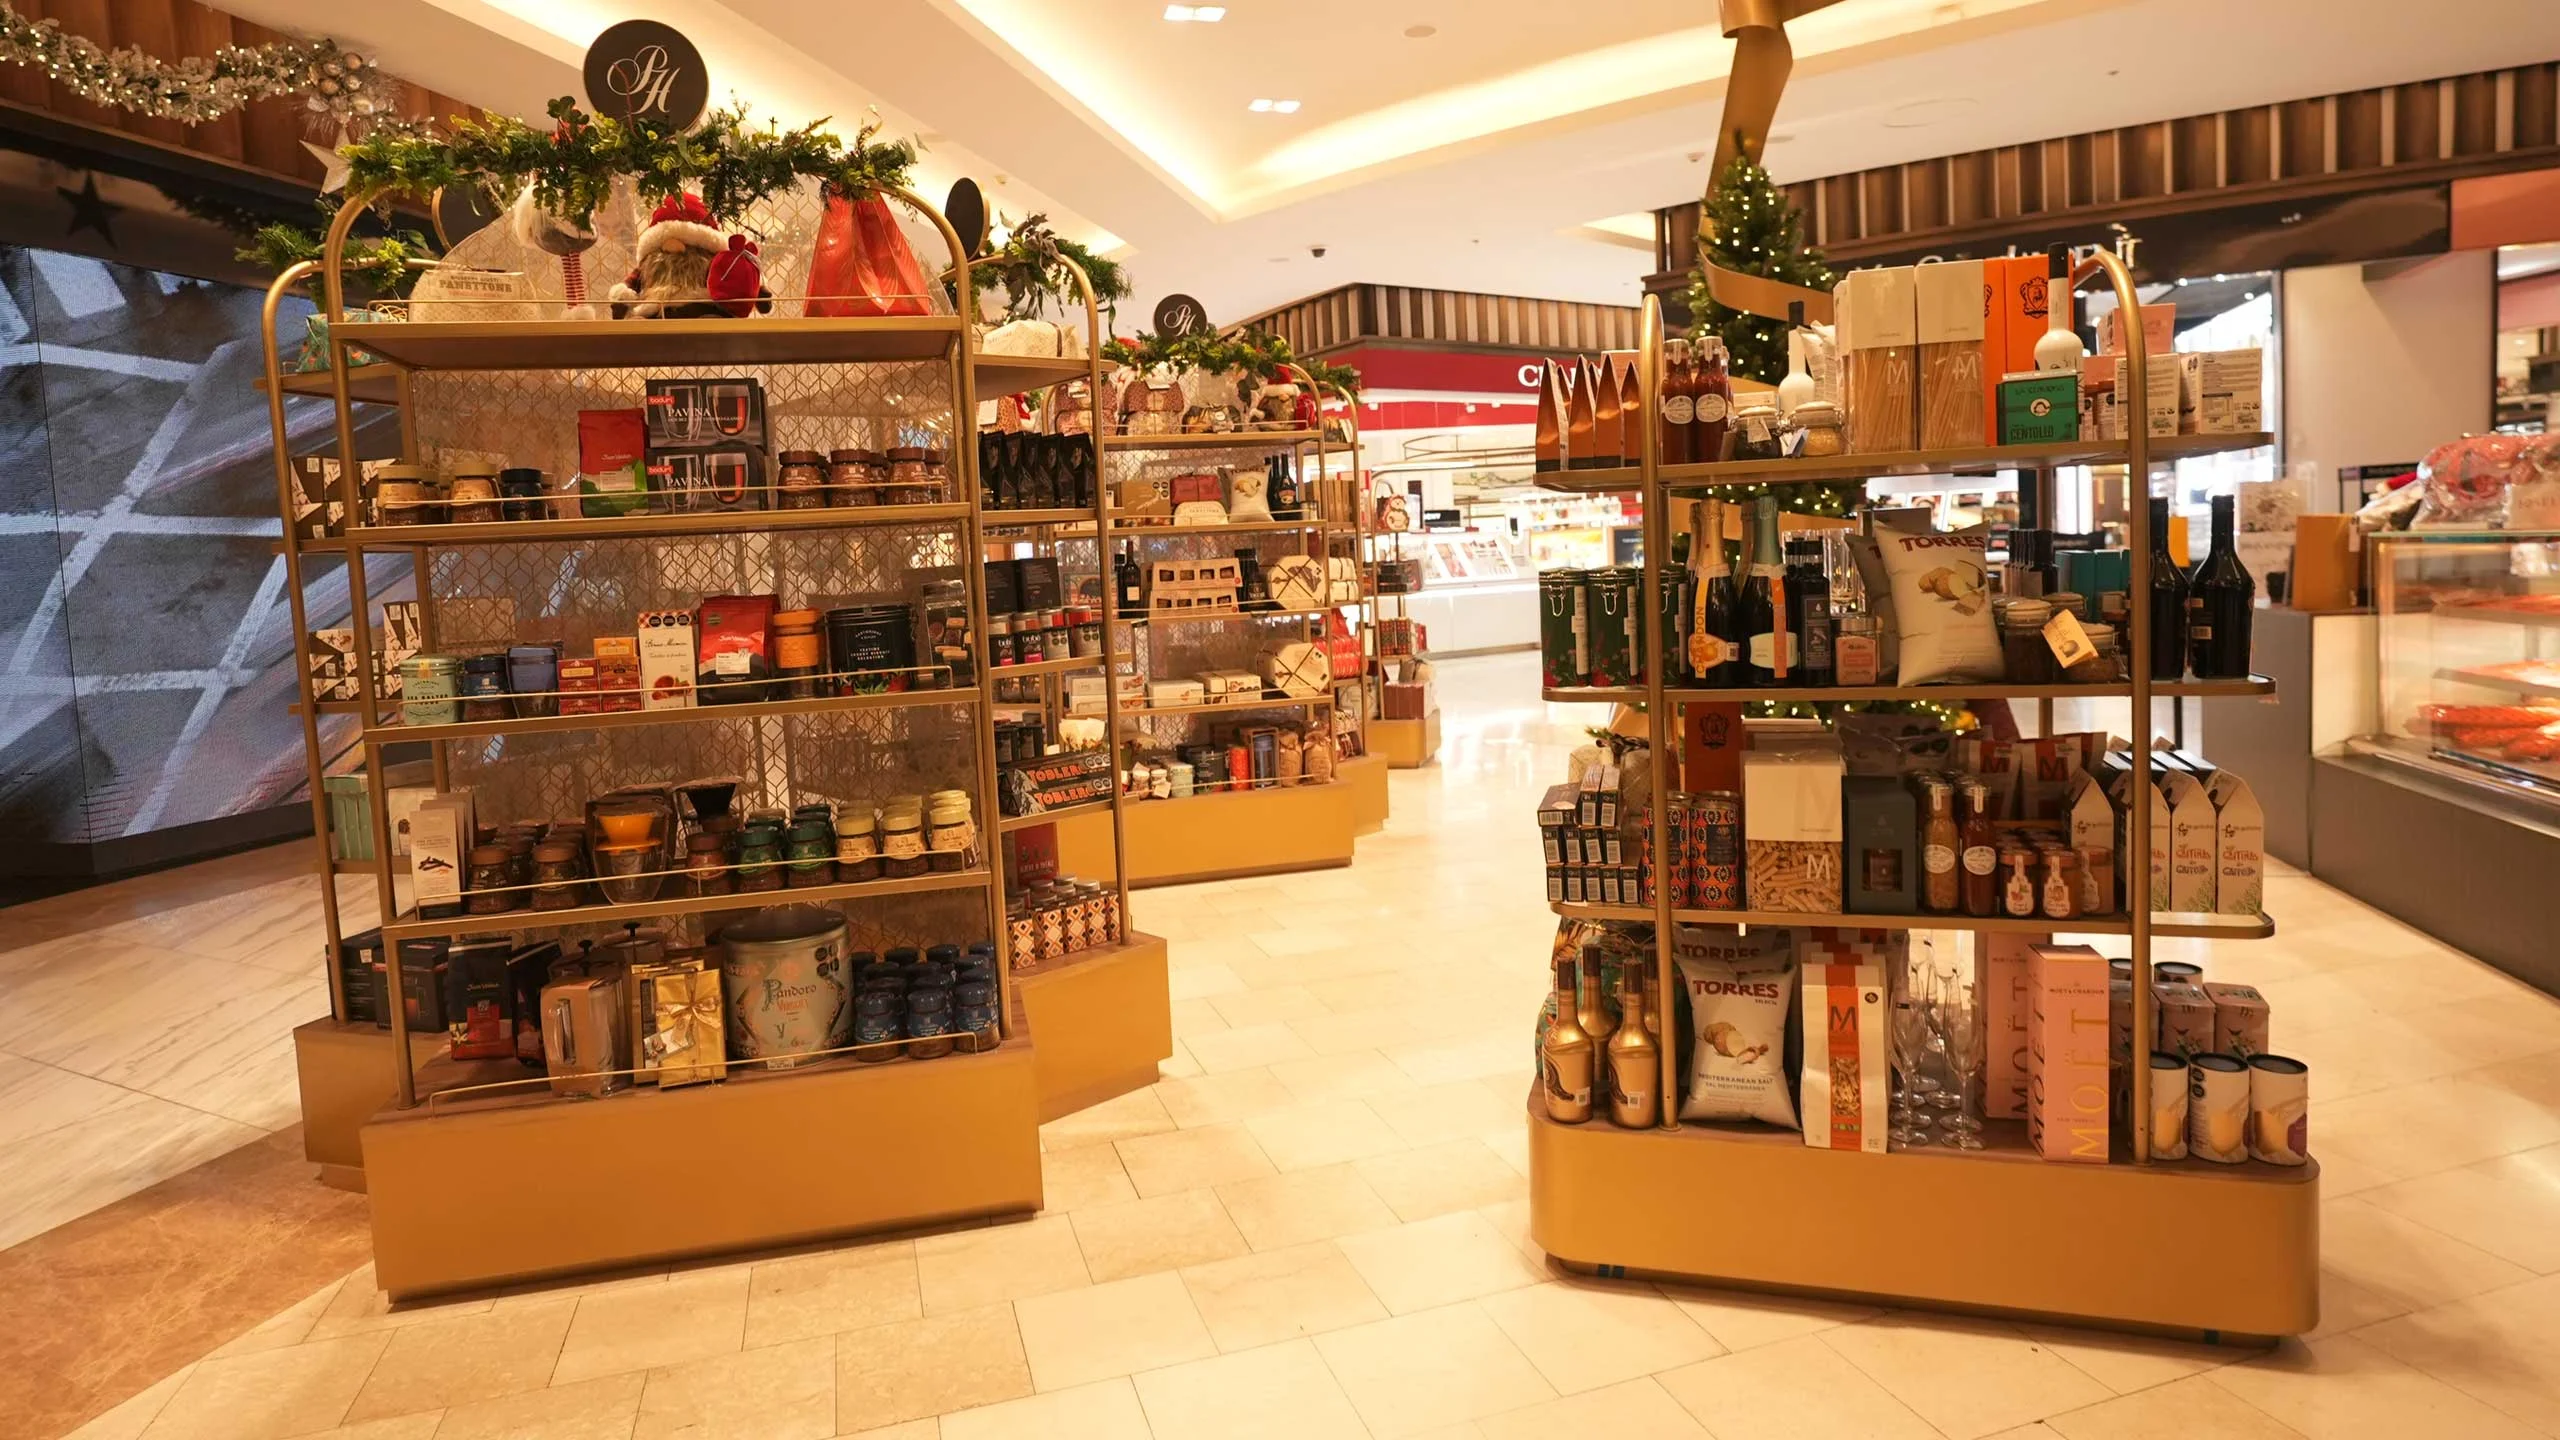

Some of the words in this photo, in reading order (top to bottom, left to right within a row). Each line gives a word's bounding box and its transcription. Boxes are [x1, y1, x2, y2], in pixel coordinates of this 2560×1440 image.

[606, 45, 681, 115] PH
[440, 279, 513, 293] PANETTONE
[1887, 359, 1909, 385] M
[667, 407, 712, 417] PAVINA
[666, 477, 710, 488] PAVINA
[1898, 535, 1986, 552] TORRES
[1807, 854, 1831, 881] M
[762, 978, 817, 1012] Pandoro
[1693, 980, 1779, 998] TORRES
[1830, 1005, 1857, 1031] M
[2064, 1008, 2109, 1158] MOËT
